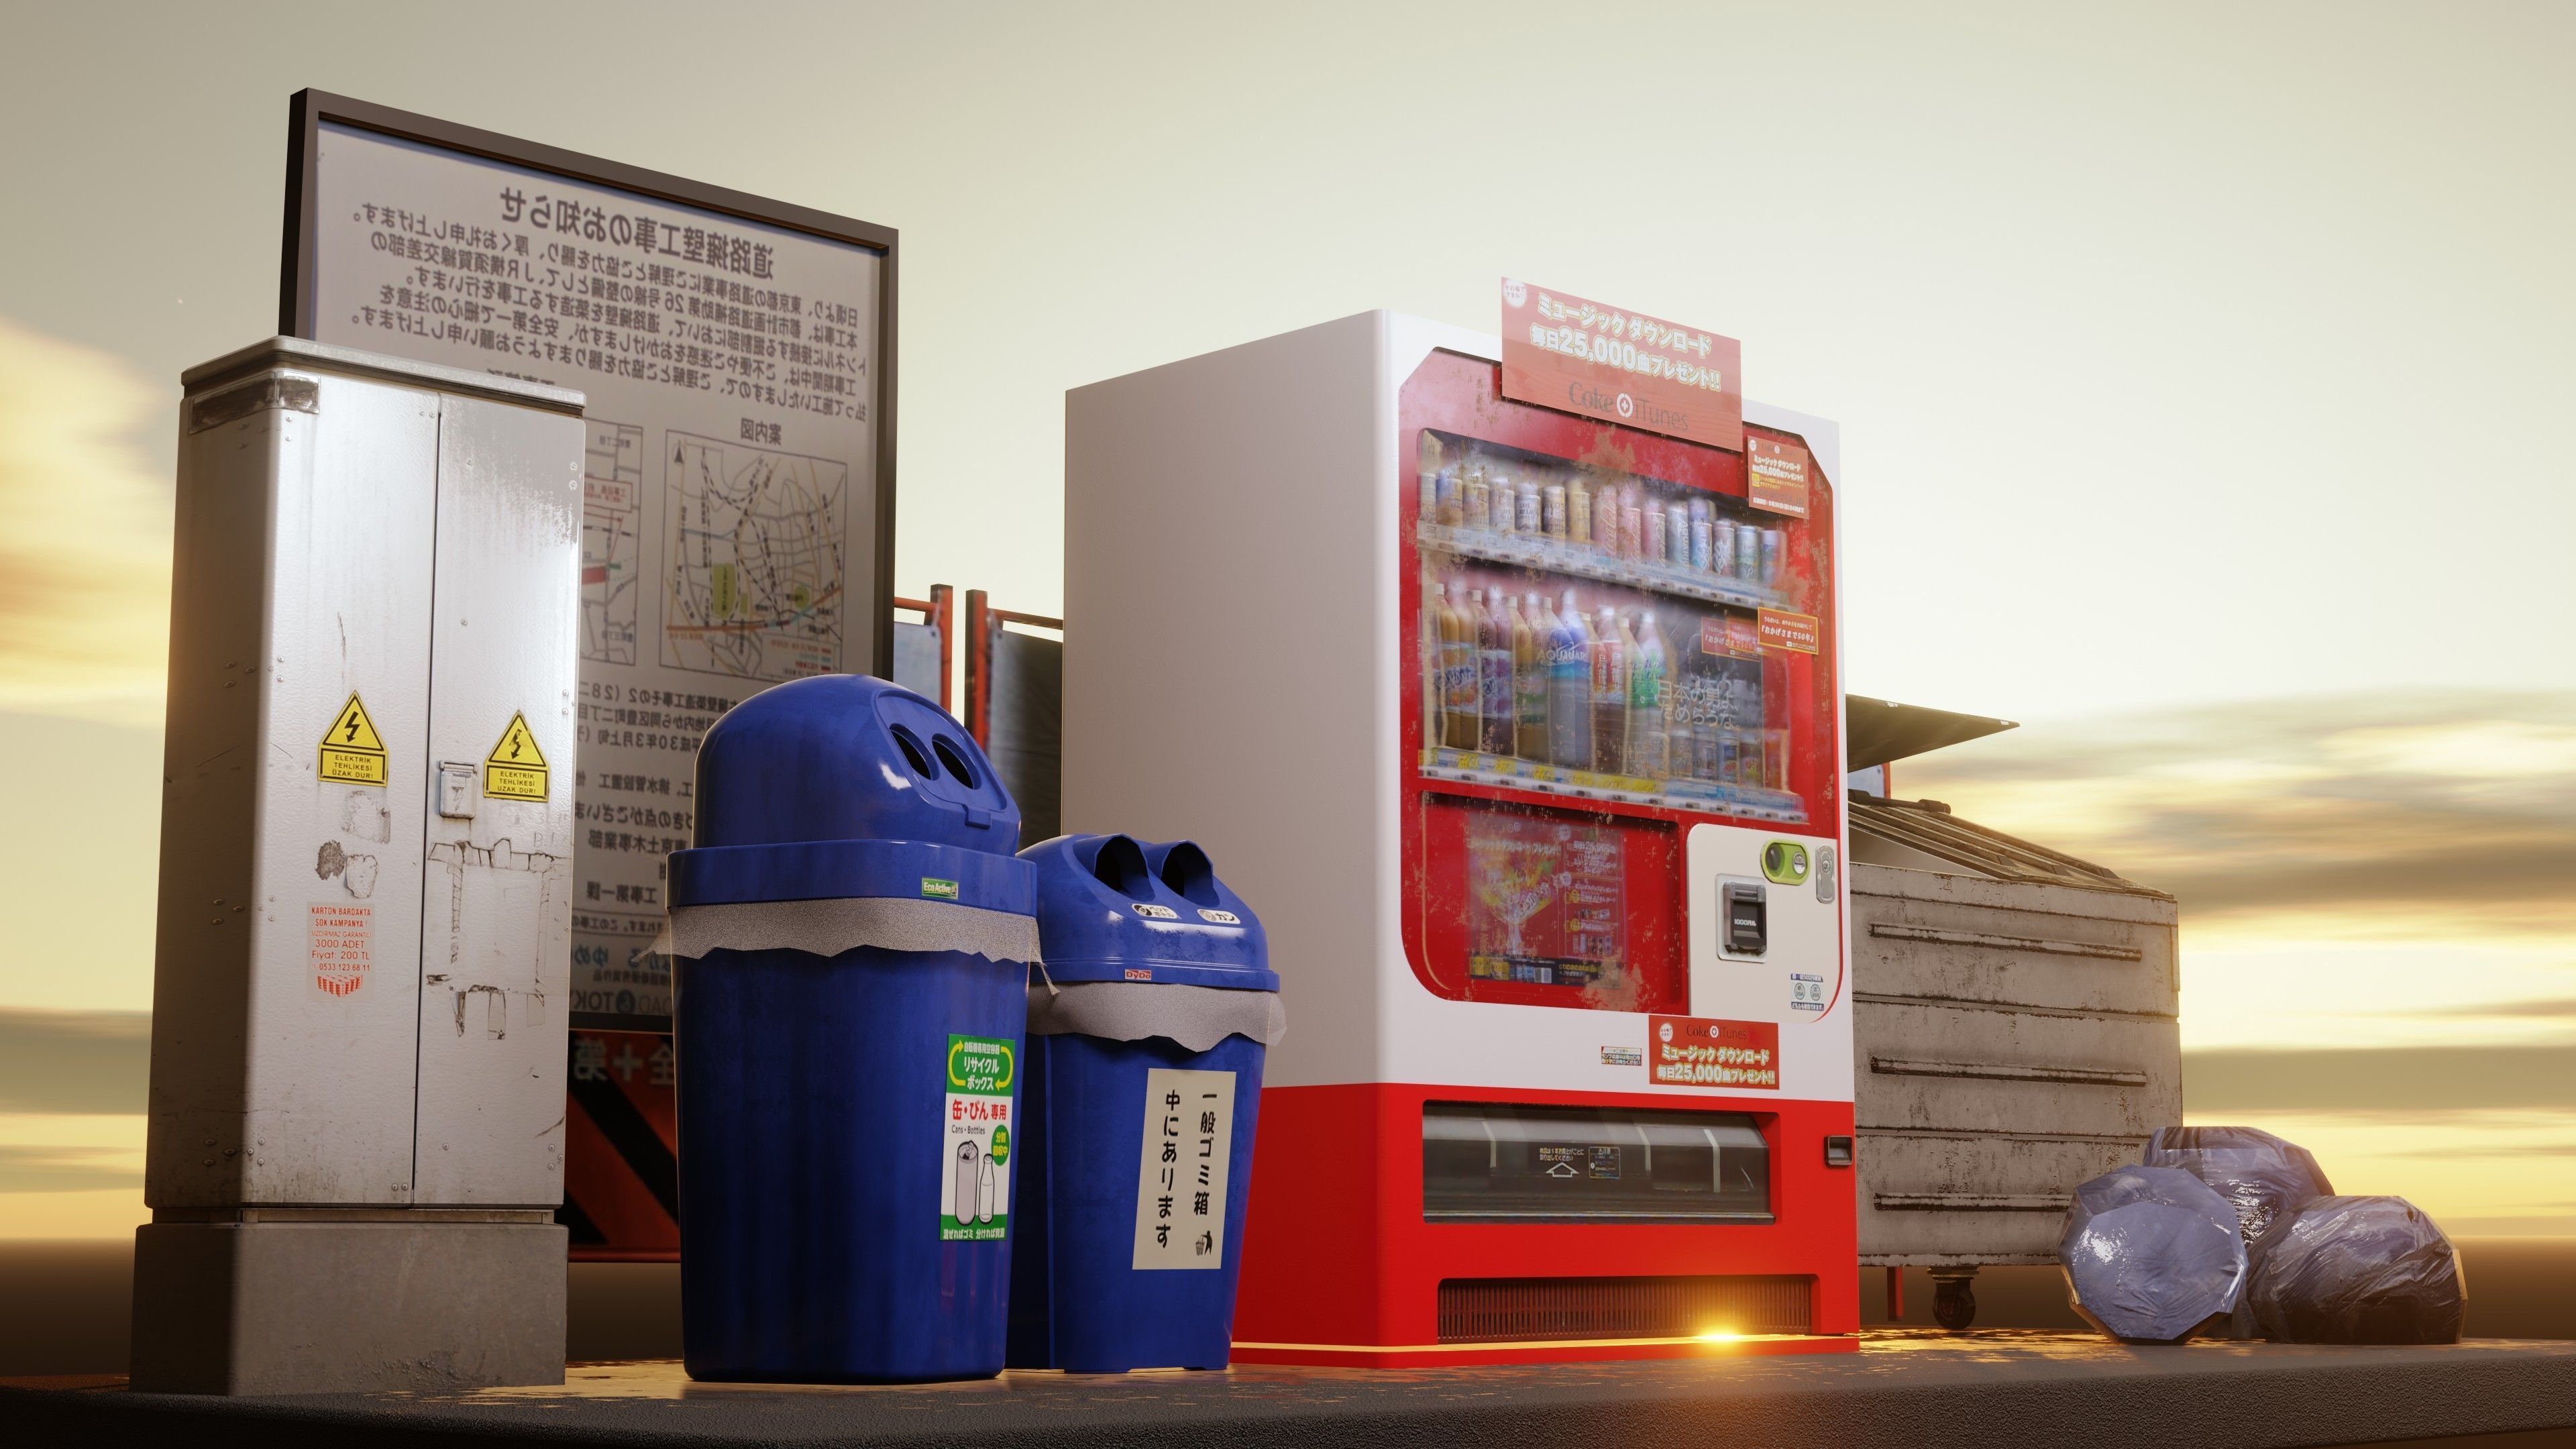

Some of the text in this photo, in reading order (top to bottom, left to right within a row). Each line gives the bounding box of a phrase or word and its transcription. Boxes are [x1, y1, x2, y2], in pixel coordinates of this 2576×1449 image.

[1538, 292, 1712, 359] ミュージック ダウンロード
[1529, 323, 1721, 391] 毎日25,000曲プレゼント!!
[1568, 381, 1689, 431] Coke iTunes
[332, 769, 374, 780] UZAK DUR!
[497, 786, 536, 794] UZAK DUR!
[924, 881, 951, 894] Eco Active
[311, 907, 370, 916] KARTON BARDAKTA
[1215, 912, 1235, 921] カン
[315, 939, 365, 949] 3000 ADET
[341, 951, 358, 959] 200
[361, 951, 370, 960] TL
[319, 963, 335, 971] 0533
[339, 963, 350, 971] 123
[352, 963, 360, 971] 68
[1126, 971, 1151, 979] DyDo
[1686, 1024, 1709, 1037] Coke
[1662, 1043, 1715, 1063] ミュージック
[1717, 1046, 1770, 1065] ダウンロード
[963, 1056, 1000, 1074] リサイクル
[967, 1075, 994, 1091] ボックス
[1193, 1091, 1218, 1216] 一般ゴミ箱
[1155, 1089, 1181, 1249] 中にあります
